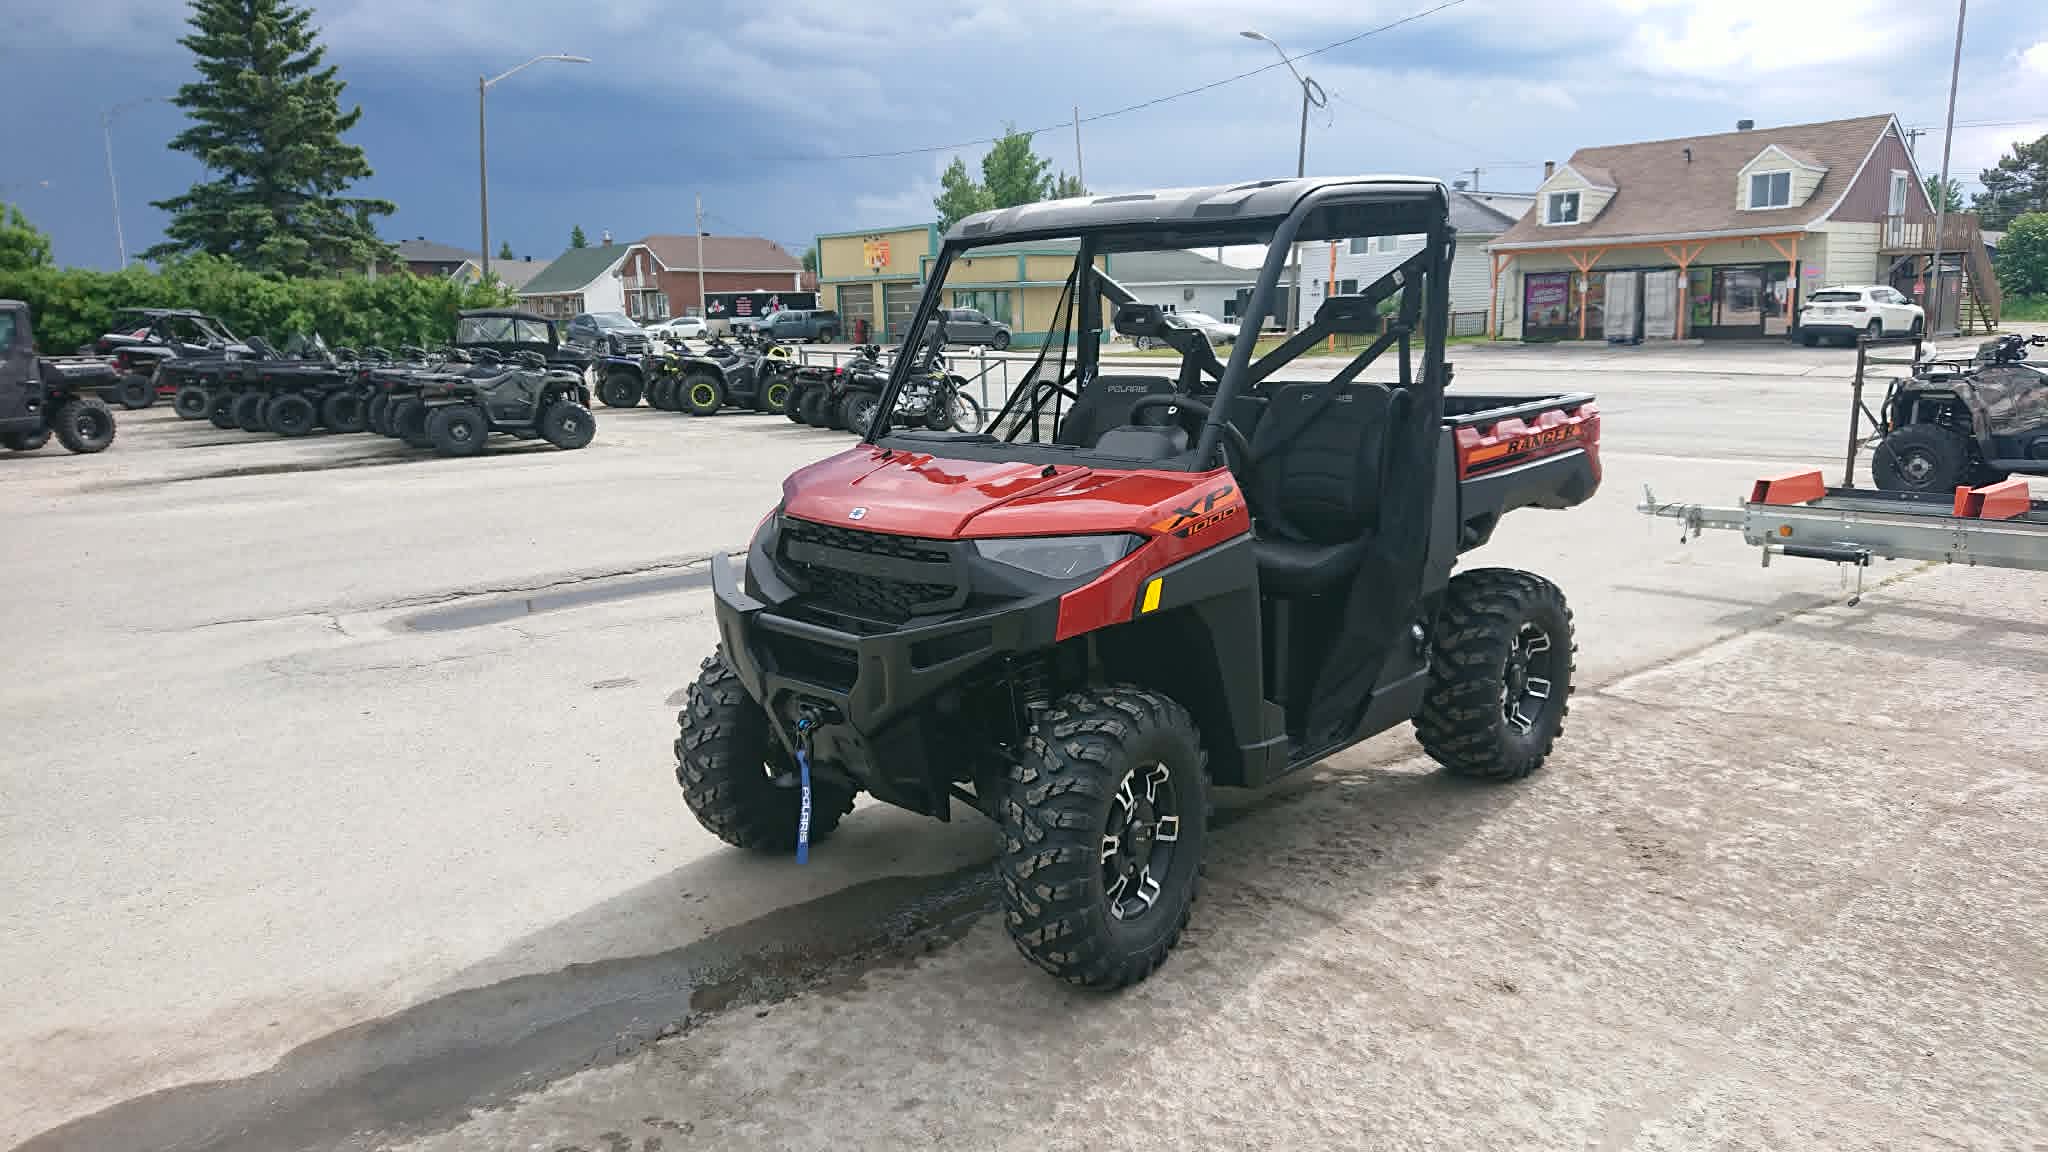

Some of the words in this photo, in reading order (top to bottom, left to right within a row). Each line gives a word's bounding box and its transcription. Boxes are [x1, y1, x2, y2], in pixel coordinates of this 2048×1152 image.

[1107, 384, 1148, 393] POLARIS
[1507, 423, 1577, 454] RANGER
[1170, 484, 1233, 529] XP
[1186, 504, 1238, 536] 1000
[800, 786, 811, 843] POLARIS
